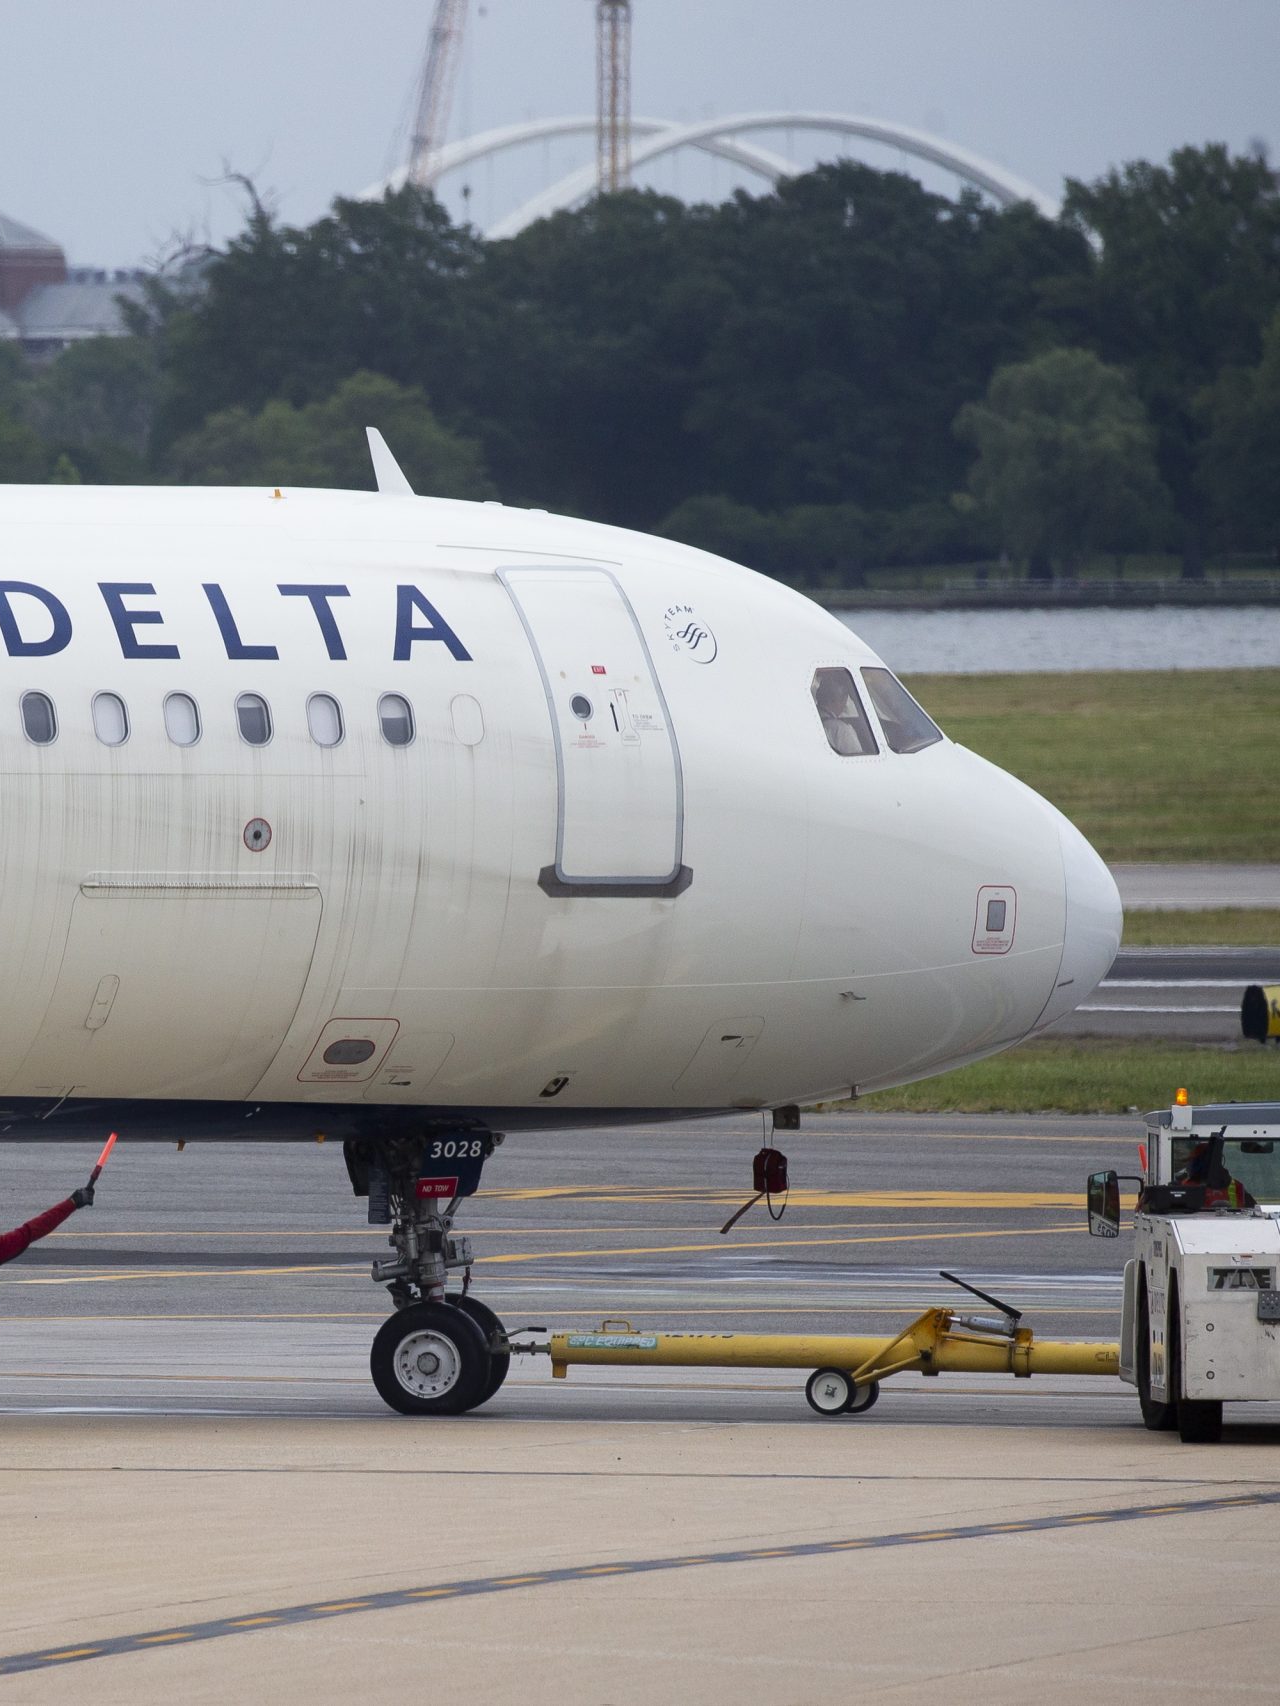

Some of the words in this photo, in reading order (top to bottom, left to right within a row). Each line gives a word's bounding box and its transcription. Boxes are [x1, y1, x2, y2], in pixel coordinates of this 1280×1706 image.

[664, 605, 693, 652] SKYTEAM
[430, 1140, 482, 1158] 3028
[434, 1184, 449, 1192] TOW
